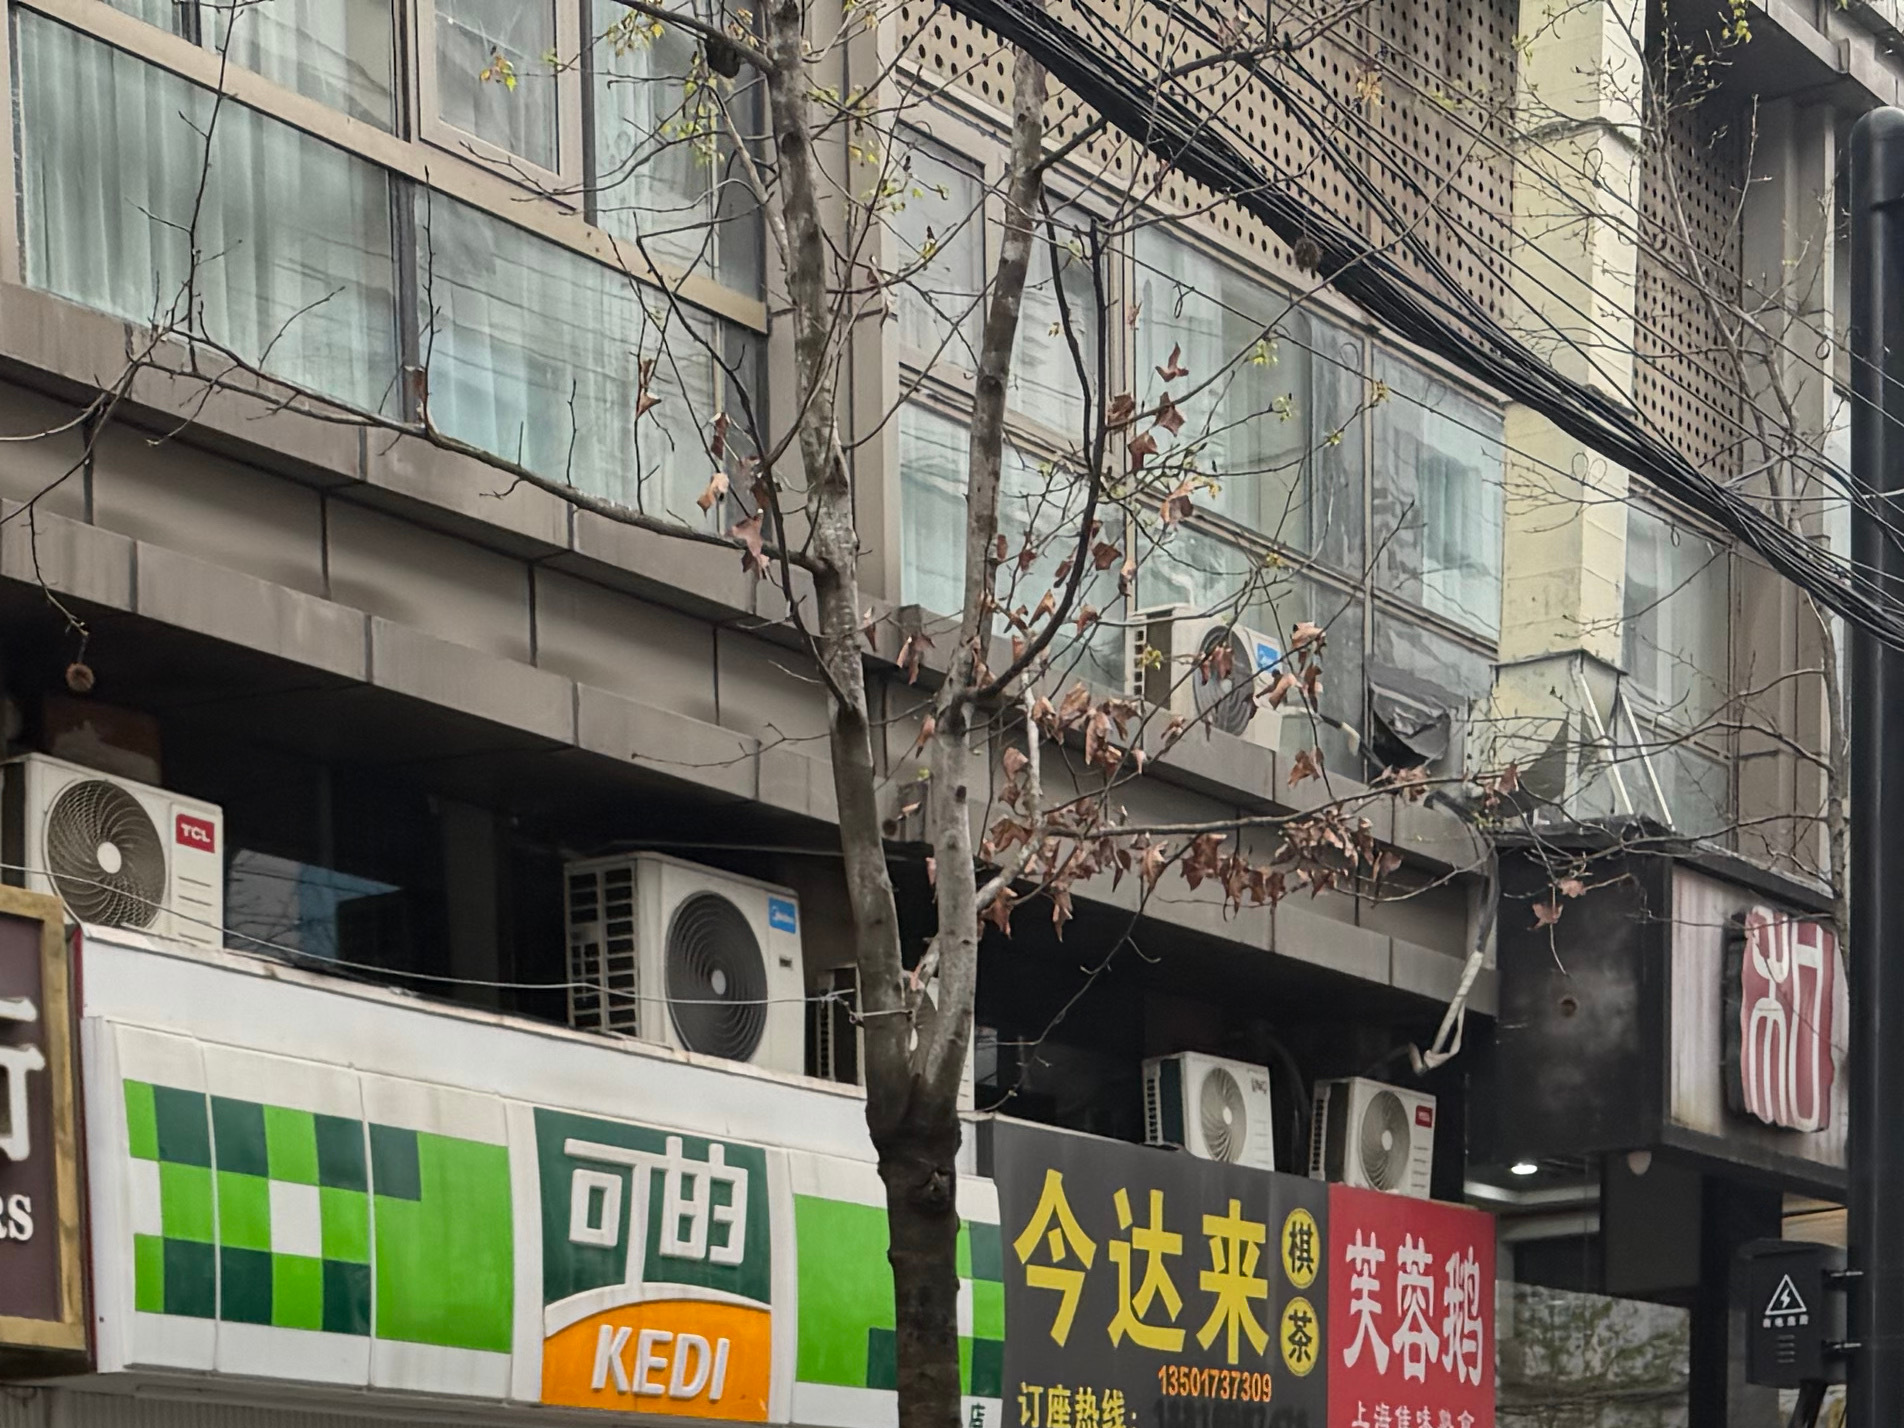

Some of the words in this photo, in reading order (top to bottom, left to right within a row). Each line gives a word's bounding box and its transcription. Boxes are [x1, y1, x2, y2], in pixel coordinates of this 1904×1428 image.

[181, 825, 211, 847] TCL
[564, 1136, 745, 1287] 可的
[1013, 1168, 1269, 1365] 今达来
[591, 1323, 732, 1401] KEDI
[1343, 1228, 1484, 1388] 芙蓉鹅
[1157, 1364, 1273, 1403] 13501737309
